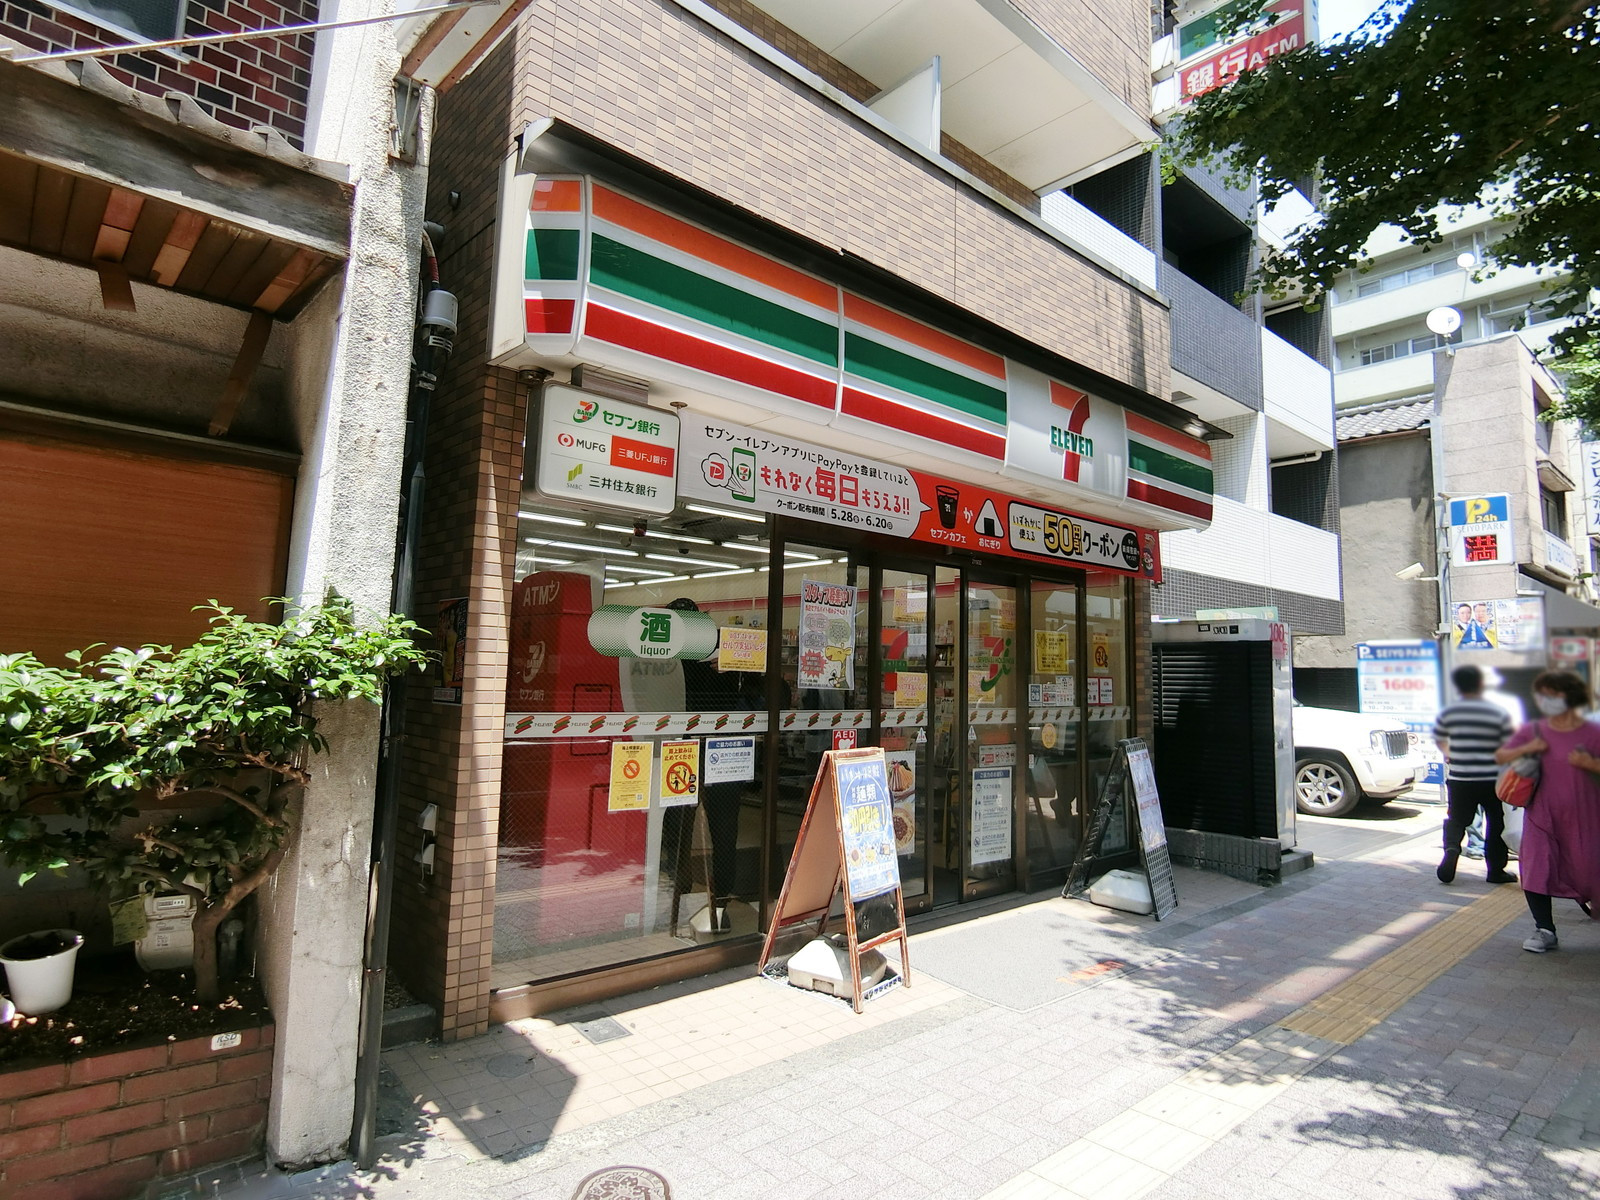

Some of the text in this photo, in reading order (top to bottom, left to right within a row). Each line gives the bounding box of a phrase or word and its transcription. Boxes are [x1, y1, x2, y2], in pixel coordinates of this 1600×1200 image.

[602, 410, 660, 436] セブン銀行
[576, 438, 606, 453] MUFG
[617, 448, 668, 466] 三菱UFJ銀行
[588, 475, 657, 498] 三井住友銀行
[1465, 498, 1491, 524] P
[1012, 515, 1042, 530] いずれかに
[1457, 522, 1506, 534] SEIYO PARK
[930, 527, 967, 545] セブンカフェ
[1018, 528, 1036, 542] 使える
[978, 537, 1001, 550] おにぎり
[639, 611, 672, 643] 酒
[640, 644, 671, 656] liquor
[834, 730, 855, 739] AED
